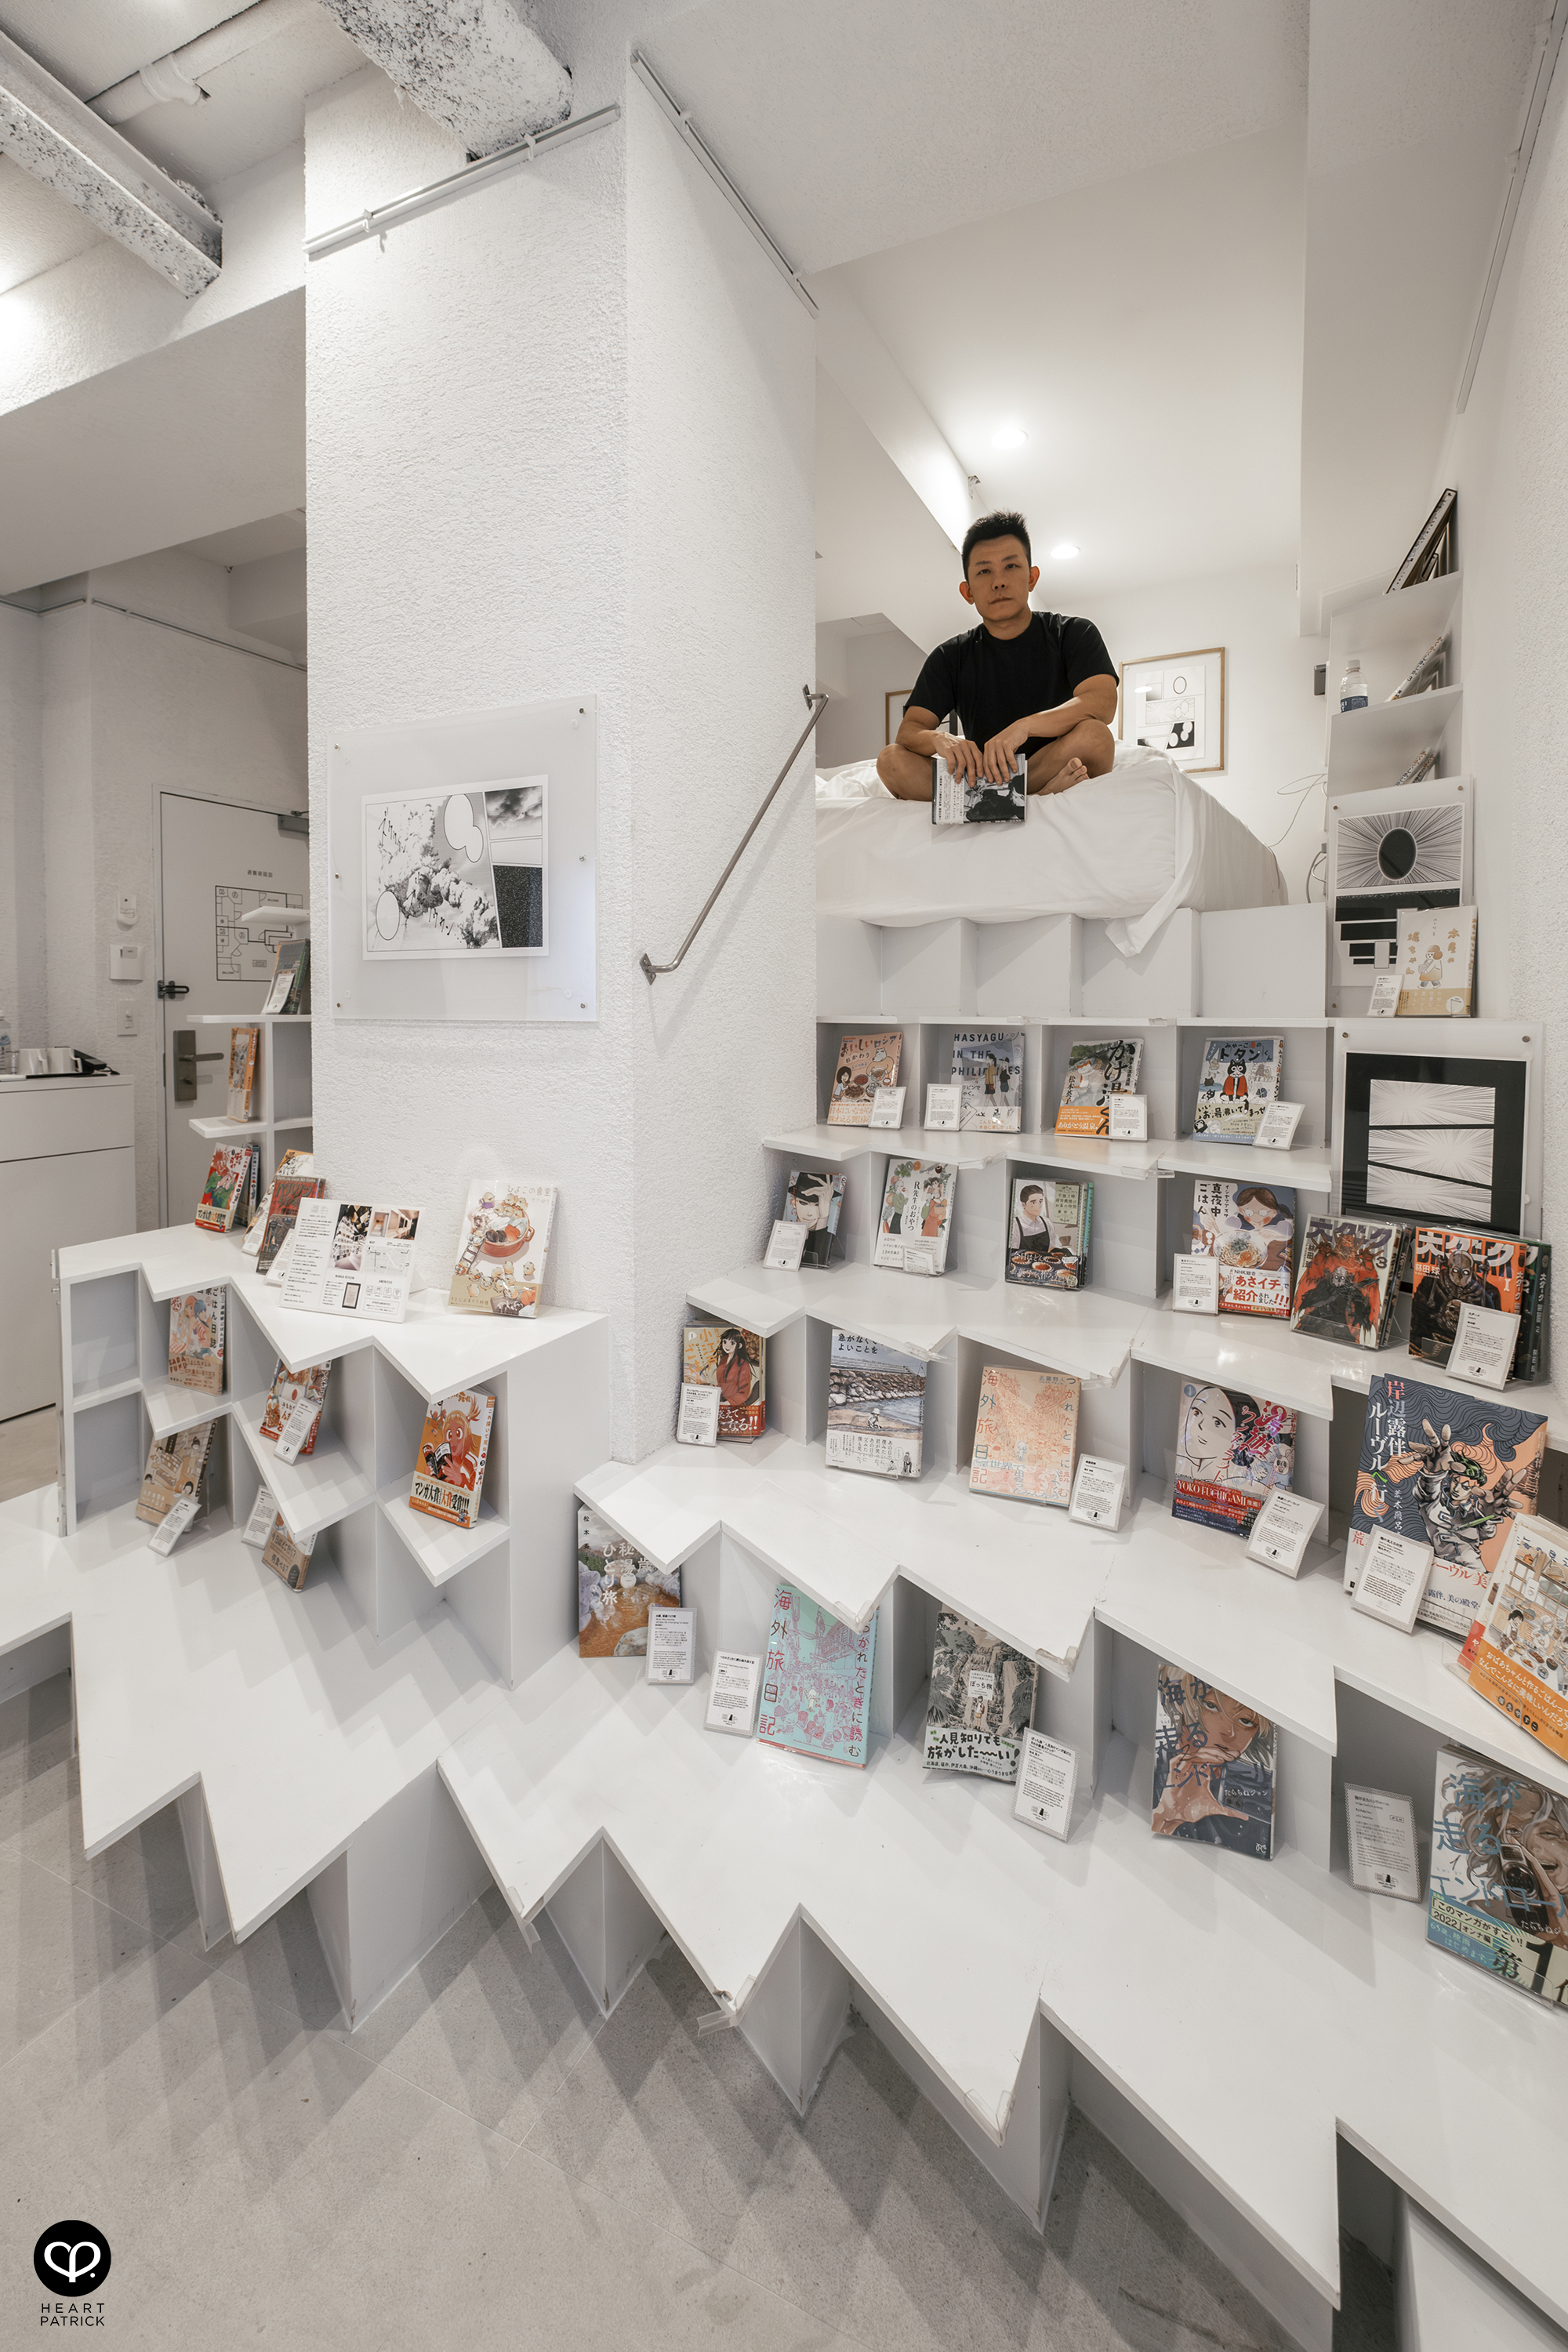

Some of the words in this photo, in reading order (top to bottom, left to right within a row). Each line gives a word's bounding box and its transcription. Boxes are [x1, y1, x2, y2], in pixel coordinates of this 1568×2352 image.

[840, 1035, 898, 1058] おいしいロシア
[953, 1033, 1004, 1042] HASYAGU
[845, 1052, 870, 1063] おかわり
[952, 1050, 963, 1058] IN
[1220, 1048, 1273, 1062] トタンくん
[1065, 1075, 1076, 1105] 松本英子
[275, 1183, 313, 1198] ベルリン
[506, 1185, 552, 1197] ひよこの食堂
[1197, 1183, 1211, 1215] ごはん
[1210, 1183, 1223, 1218] 真夜中
[908, 1181, 920, 1232] R先生のおやつ
[1375, 1255, 1388, 1269] 3
[1417, 1232, 1515, 1267] 大ダーク
[1414, 1262, 1441, 1275] 林田球
[1232, 1288, 1258, 1303] 紹介
[1537, 1272, 1547, 1302] 大ダーク
[838, 1343, 879, 1355] よいことを
[971, 1369, 1000, 1485] 海外旅日記
[1386, 1380, 1407, 1457] 岸辺露伴
[1057, 1377, 1076, 1498] つかれたときに読む
[1368, 1402, 1389, 1523] ルーヴルへ行く
[415, 1482, 441, 1504] マンガ大賞
[440, 1489, 453, 1508] 大賞
[1177, 1479, 1201, 1494] YOKO
[1201, 1486, 1247, 1506] FUCHIGAMI
[1393, 1490, 1403, 1534] 荒木飛呂
[1352, 1530, 1365, 1547] 荒
[618, 1542, 637, 1573] 秘湯
[601, 1544, 618, 1606] ひとり旅
[758, 1588, 793, 1737] 海外旅日記
[969, 1680, 993, 1690] ぼっち旅
[1479, 1657, 1568, 1731] なんでこんなに美味しいんだろう
[1486, 1651, 1568, 1717] おばあちゃんと作るごはんって
[938, 1731, 1001, 1747] 人見知りでも
[1224, 1788, 1268, 1798] たらちねジョン
[1450, 1773, 1522, 1811] 海が
[1432, 1817, 1503, 1856] 走る
[1430, 1922, 1472, 1947] 65歳、映画
[1432, 1896, 1523, 1947] 「このマンガがすごい!
[1433, 1911, 1492, 1945] 2022」オンナ編
